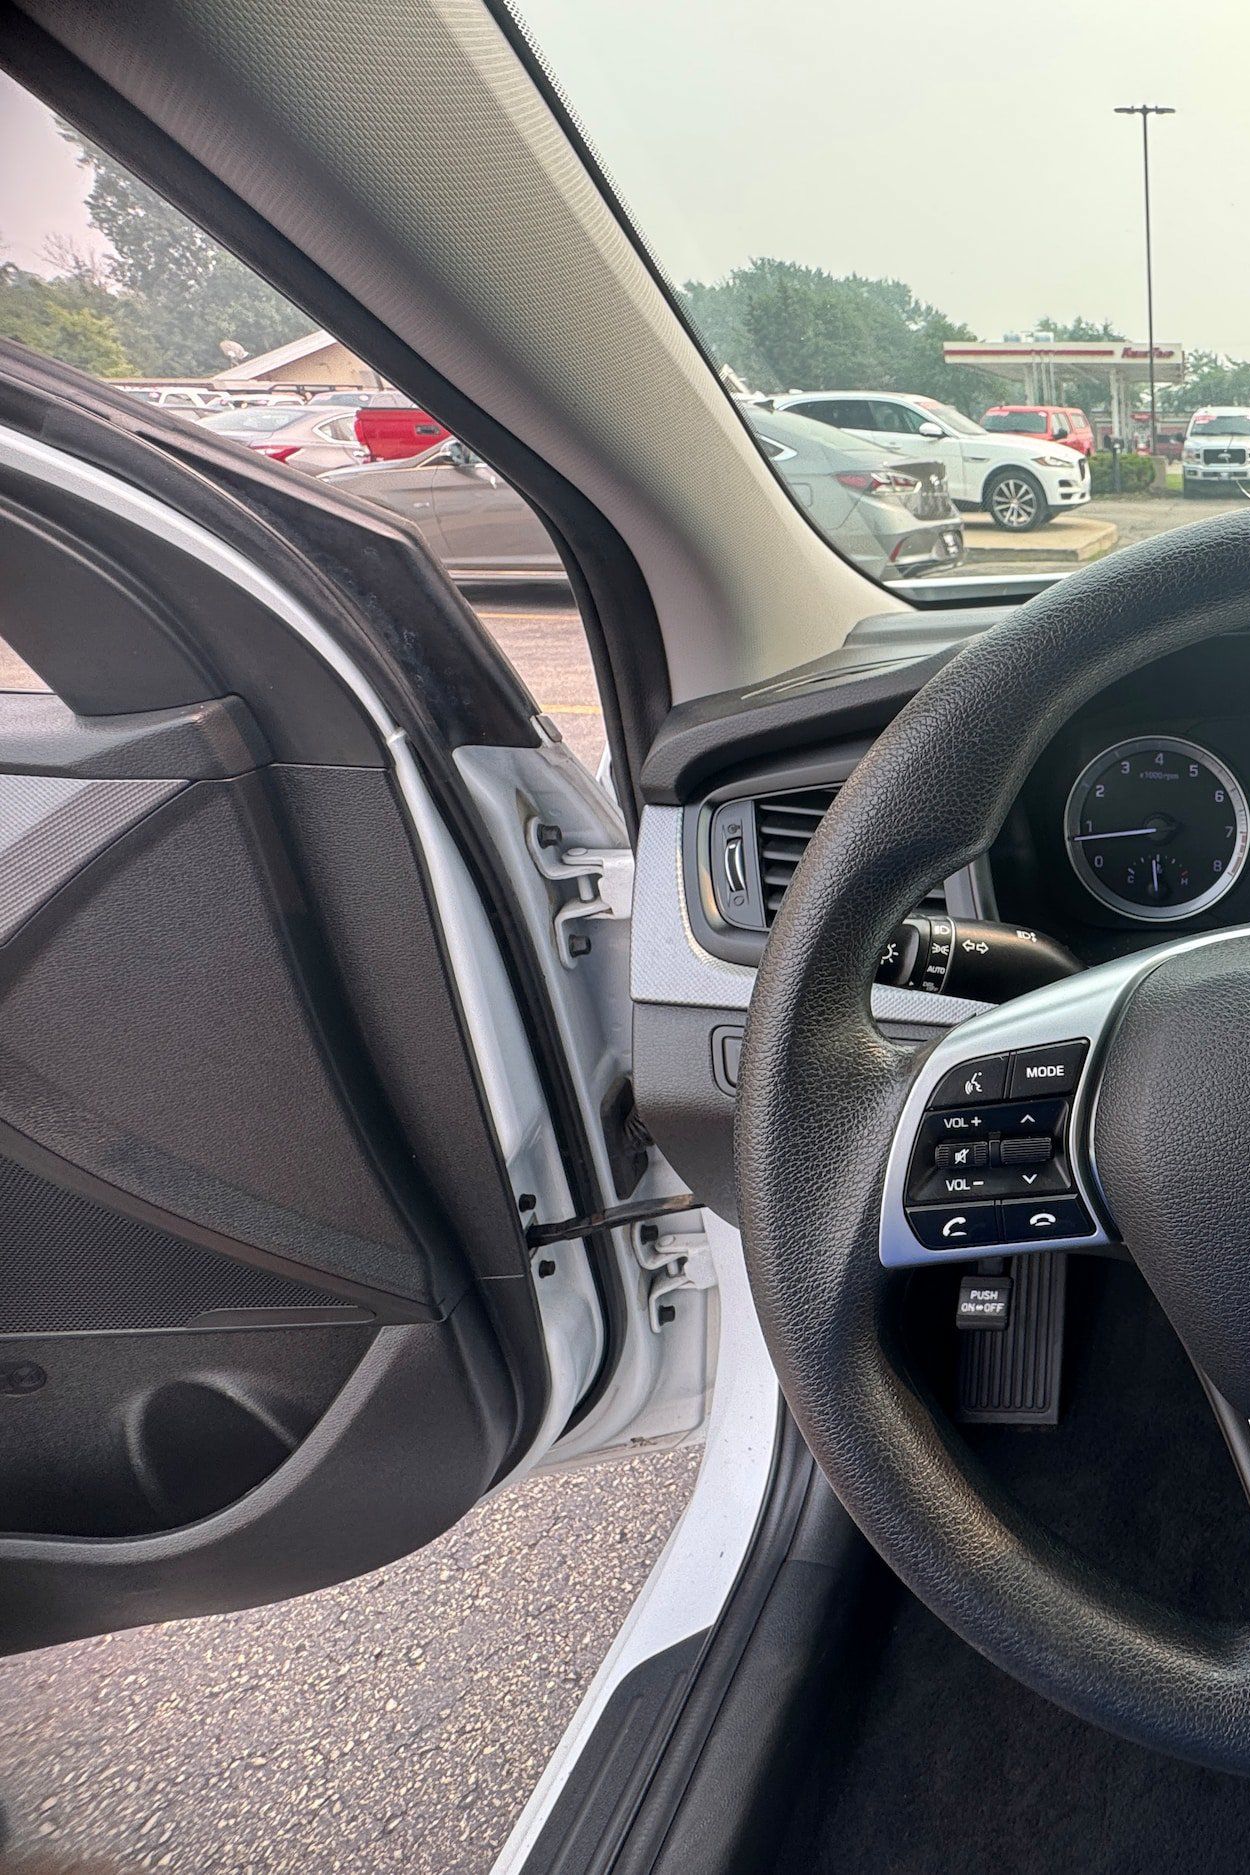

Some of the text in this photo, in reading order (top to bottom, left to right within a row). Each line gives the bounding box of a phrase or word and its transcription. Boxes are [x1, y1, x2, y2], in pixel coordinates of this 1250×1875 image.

[1155, 753, 1164, 766] 4
[1121, 761, 1130, 774] 3
[1189, 765, 1198, 777] 5
[1096, 785, 1104, 797] 2
[1214, 790, 1224, 802] 6
[1086, 821, 1092, 832] 1
[1225, 826, 1234, 838] 7
[1094, 856, 1103, 867] 0
[1214, 860, 1222, 872] 8
[926, 966, 946, 974] AUTO
[1026, 1065, 1064, 1078] MODE
[970, 1290, 998, 1300] PUSH
